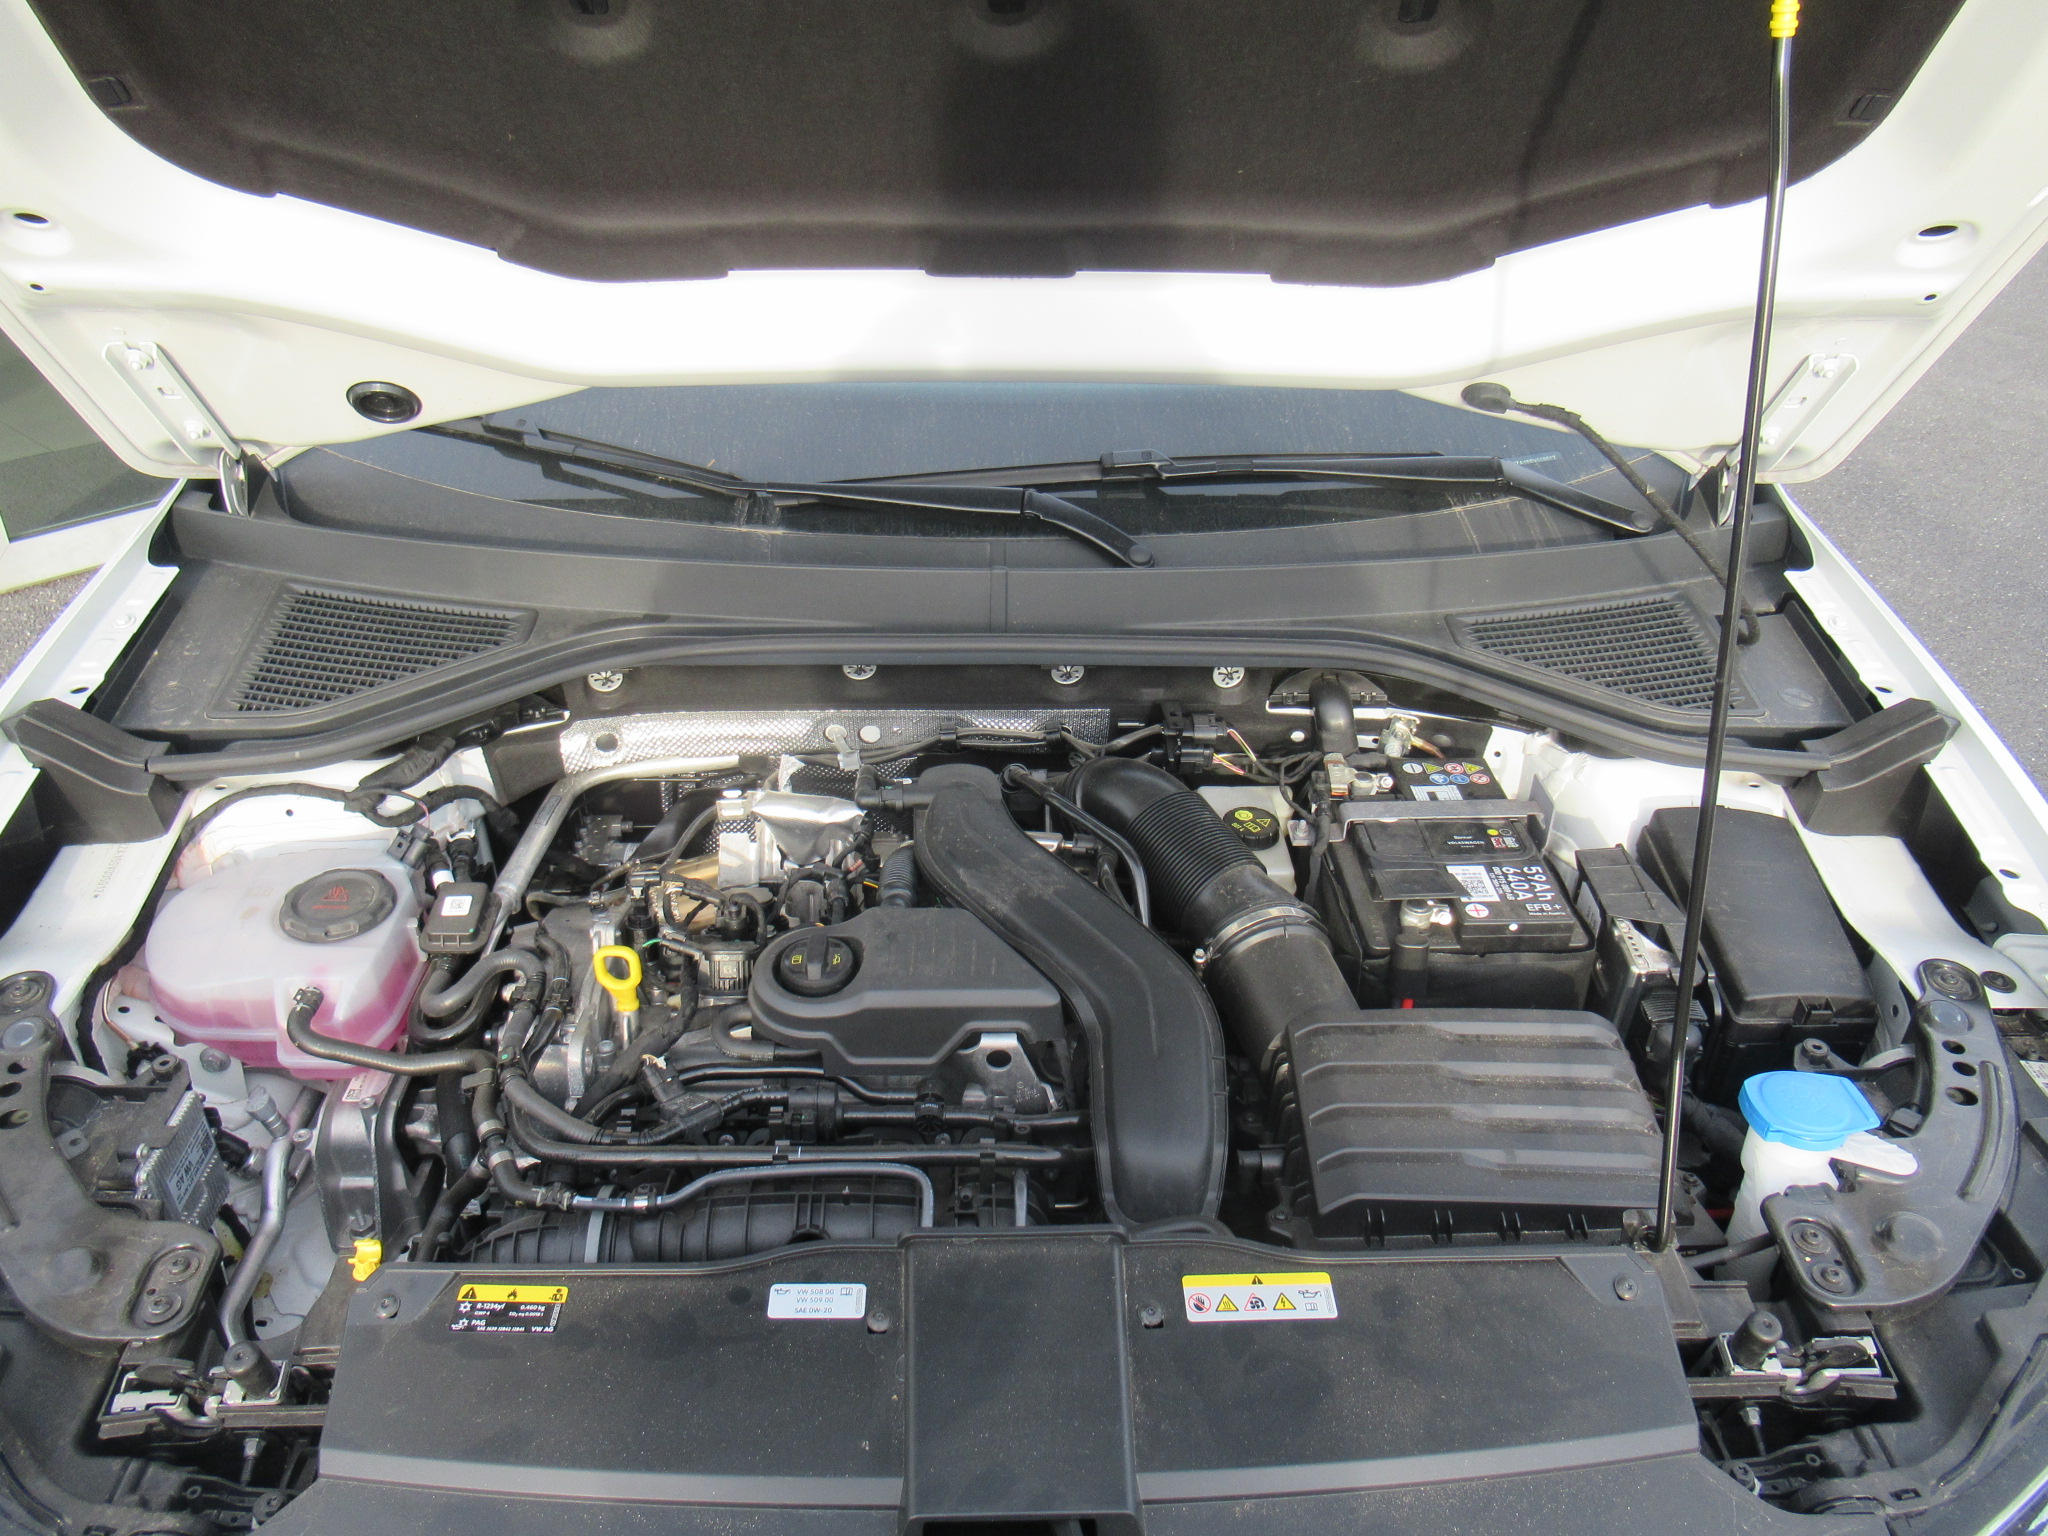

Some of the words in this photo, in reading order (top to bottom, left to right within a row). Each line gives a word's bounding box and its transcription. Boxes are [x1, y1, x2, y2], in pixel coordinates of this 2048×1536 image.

[1502, 866, 1534, 901] 640A
[1523, 866, 1555, 901] 59Ah
[184, 1161, 194, 1177] VW
[175, 1175, 185, 1192] AG
[476, 1303, 505, 1311] R-1234yf
